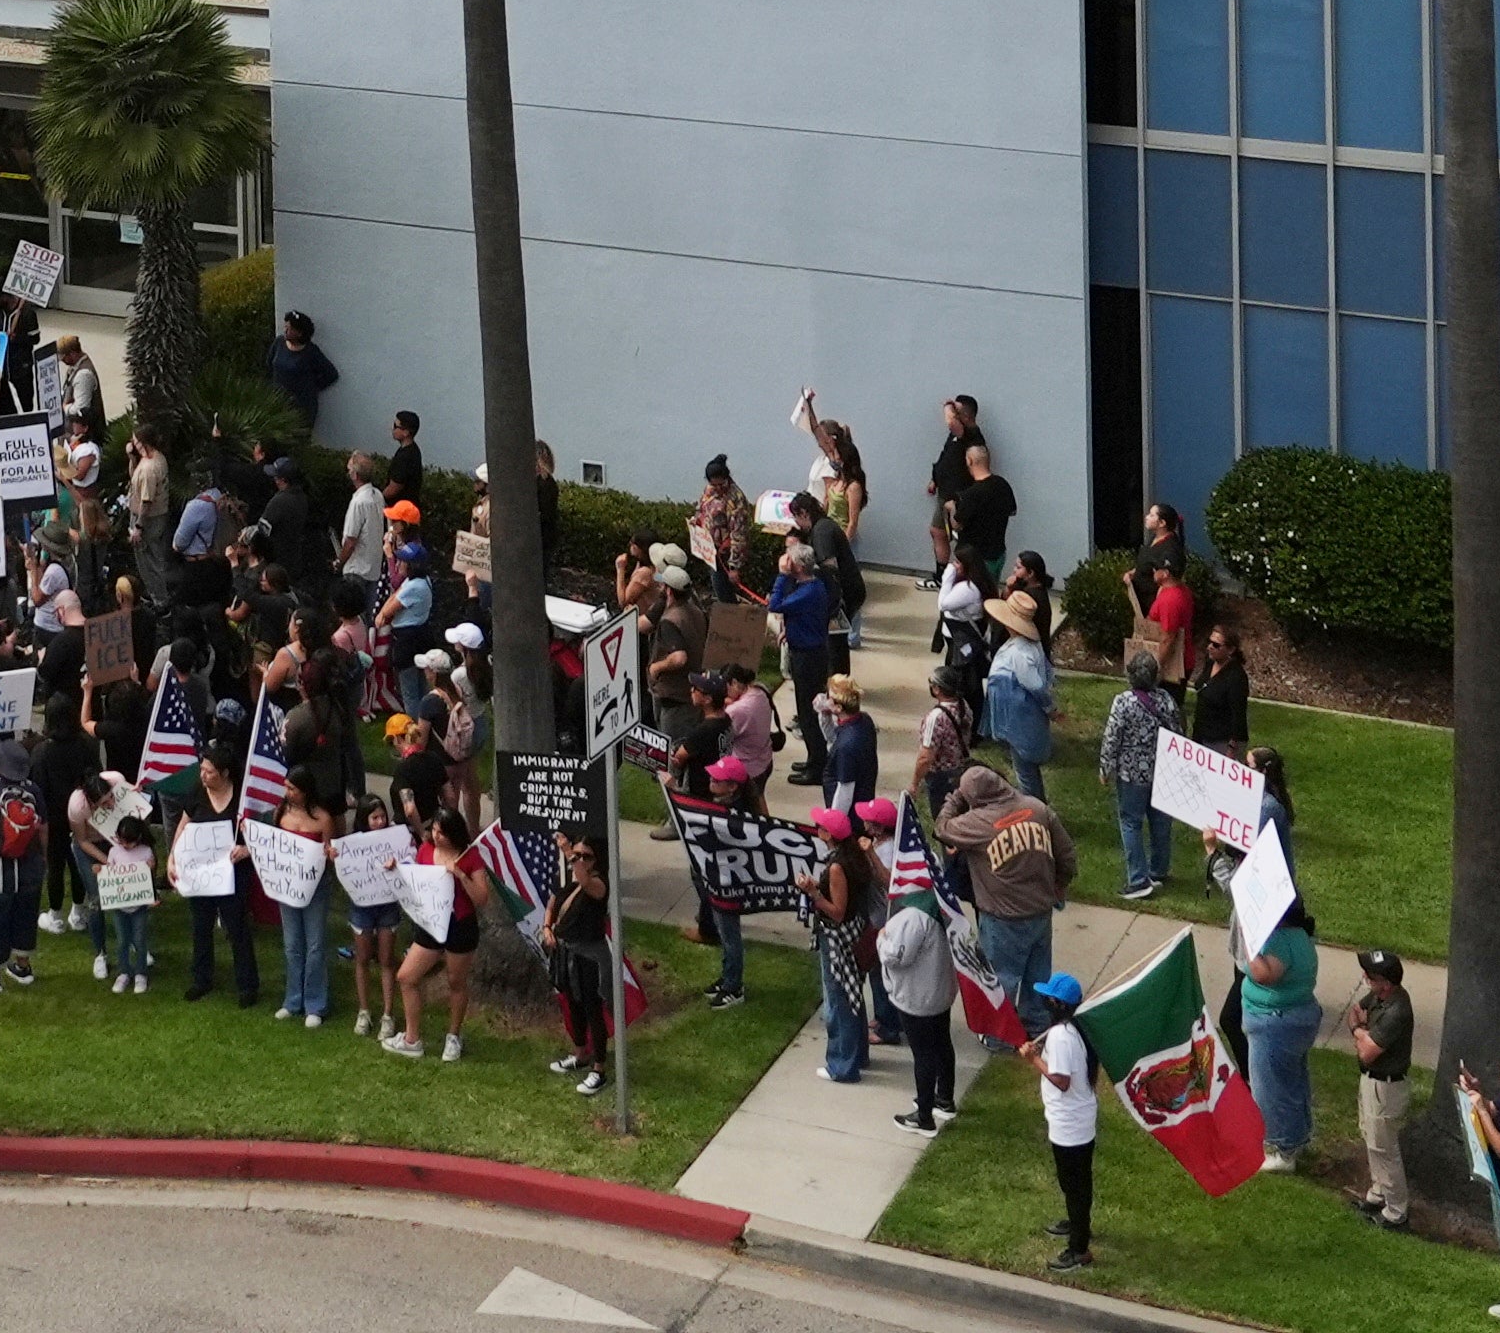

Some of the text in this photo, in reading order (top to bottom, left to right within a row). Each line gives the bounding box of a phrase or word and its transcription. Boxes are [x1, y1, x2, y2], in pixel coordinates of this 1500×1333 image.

[21, 243, 61, 264] STOP
[11, 274, 47, 298] NO
[0, 446, 46, 462] RIGHTS
[5, 437, 37, 451] FULL
[1, 464, 48, 477] FOR ALL
[89, 615, 131, 646] FUCK
[97, 642, 130, 668] ICE
[592, 683, 610, 709] HERE
[610, 711, 619, 729] TO
[513, 755, 590, 770] IMMIGRANTS
[1167, 736, 1254, 789] ABOLISH
[527, 771, 575, 782] ARE NOT
[92, 785, 129, 825] CHGA
[527, 794, 573, 808] BUT THE
[519, 803, 587, 822] PRESIDENT
[548, 819, 561, 830] IS
[1215, 810, 1254, 849] ICE
[181, 825, 226, 853] ICE
[249, 823, 305, 860] Don't Bite
[340, 841, 392, 859] America
[986, 821, 1054, 872] HEAVEN
[106, 862, 137, 877] PROUD
[267, 853, 296, 877] Hands
[297, 862, 318, 882] That
[688, 843, 826, 887] TRUM
[191, 867, 224, 892] 805
[259, 870, 307, 902] Feed You
[720, 886, 745, 898] Like
[749, 883, 785, 895] Trump
[101, 890, 152, 905] IMMIGRANTS
